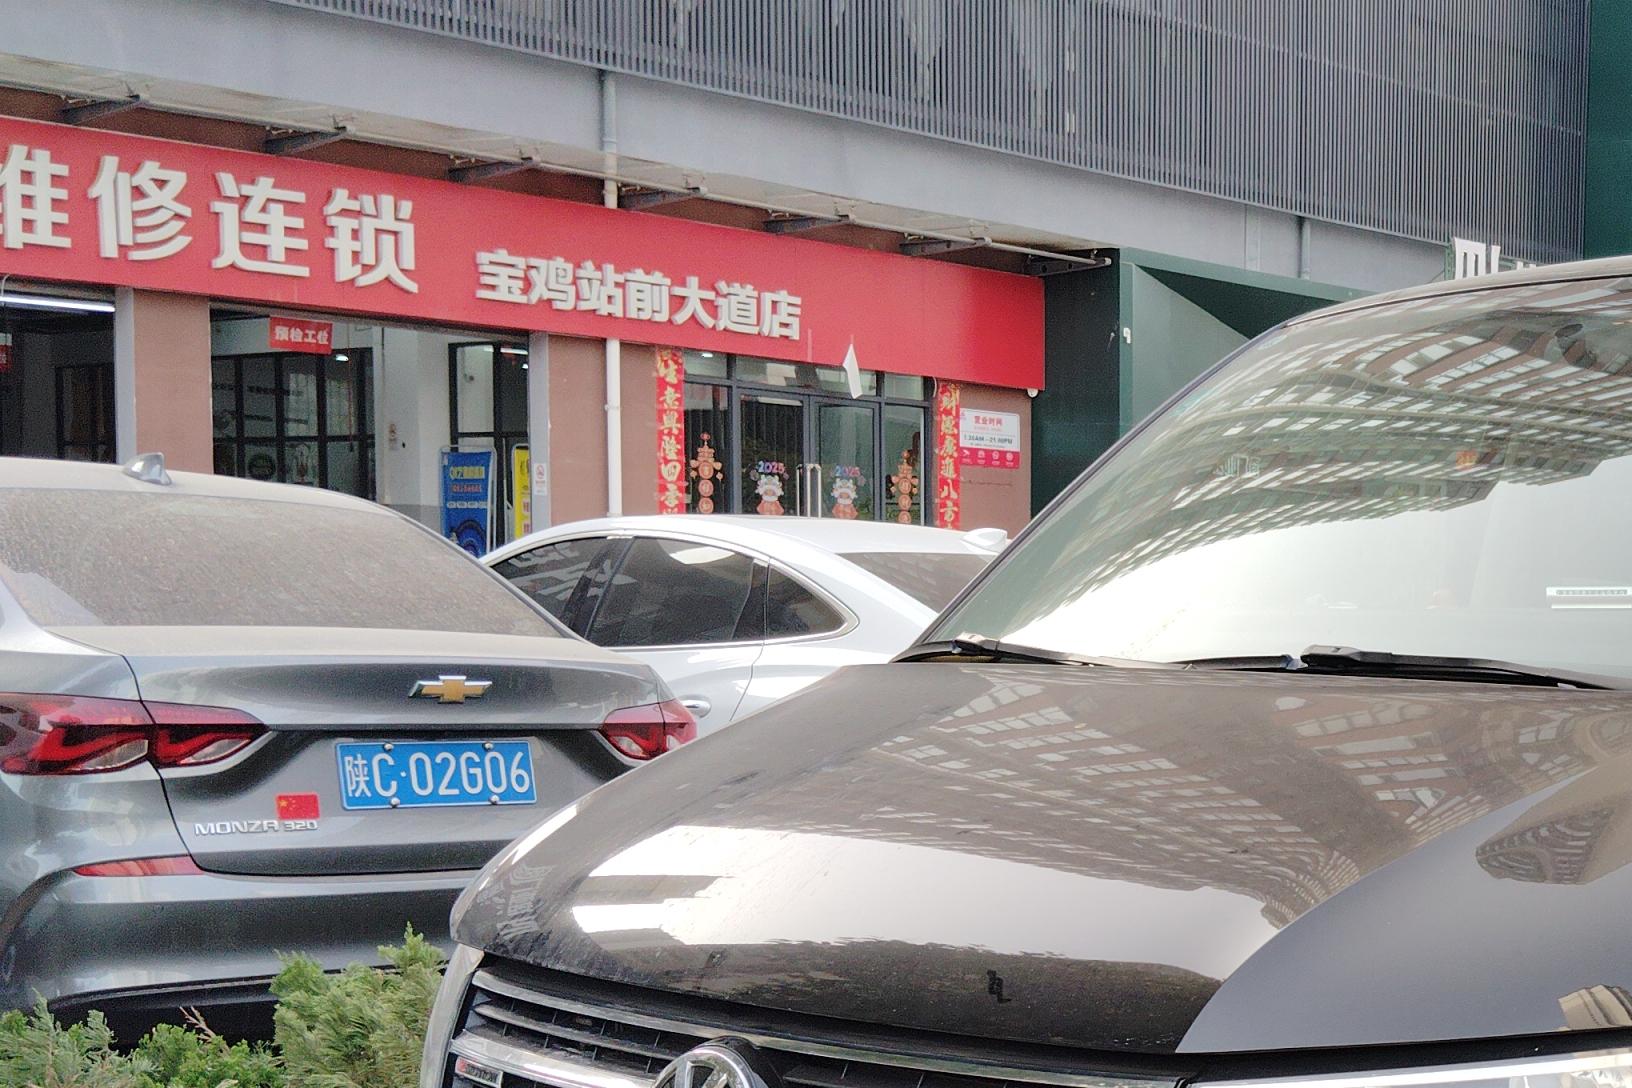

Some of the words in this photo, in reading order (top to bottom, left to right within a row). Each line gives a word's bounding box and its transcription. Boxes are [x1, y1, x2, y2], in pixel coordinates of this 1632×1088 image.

[0, 144, 419, 294] 维修连锁
[475, 248, 802, 341] 宝鸡站前大道店
[274, 324, 329, 346] 预检工位
[758, 460, 786, 473] 2025
[835, 464, 861, 477] 2025
[195, 819, 279, 836] MONZA
[284, 820, 319, 832] 320
